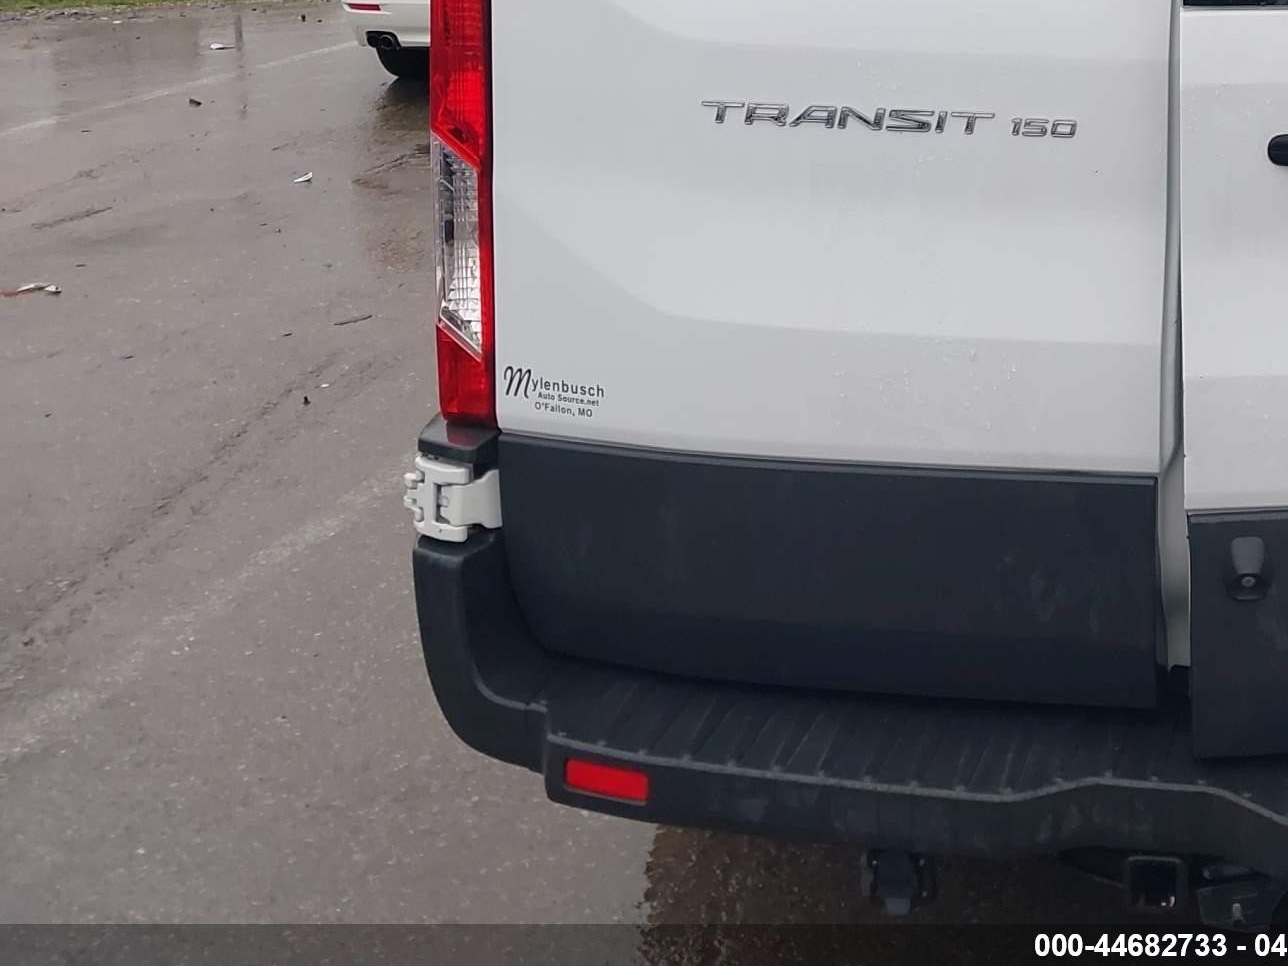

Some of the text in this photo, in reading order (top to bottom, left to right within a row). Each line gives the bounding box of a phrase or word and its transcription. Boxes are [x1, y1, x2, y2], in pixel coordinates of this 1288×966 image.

[701, 100, 1077, 138] TRANSIT 150
[503, 365, 605, 399] Mylenbusch
[534, 401, 593, 418] O'Fallon, MO
[538, 391, 600, 407] Auto Source.net
